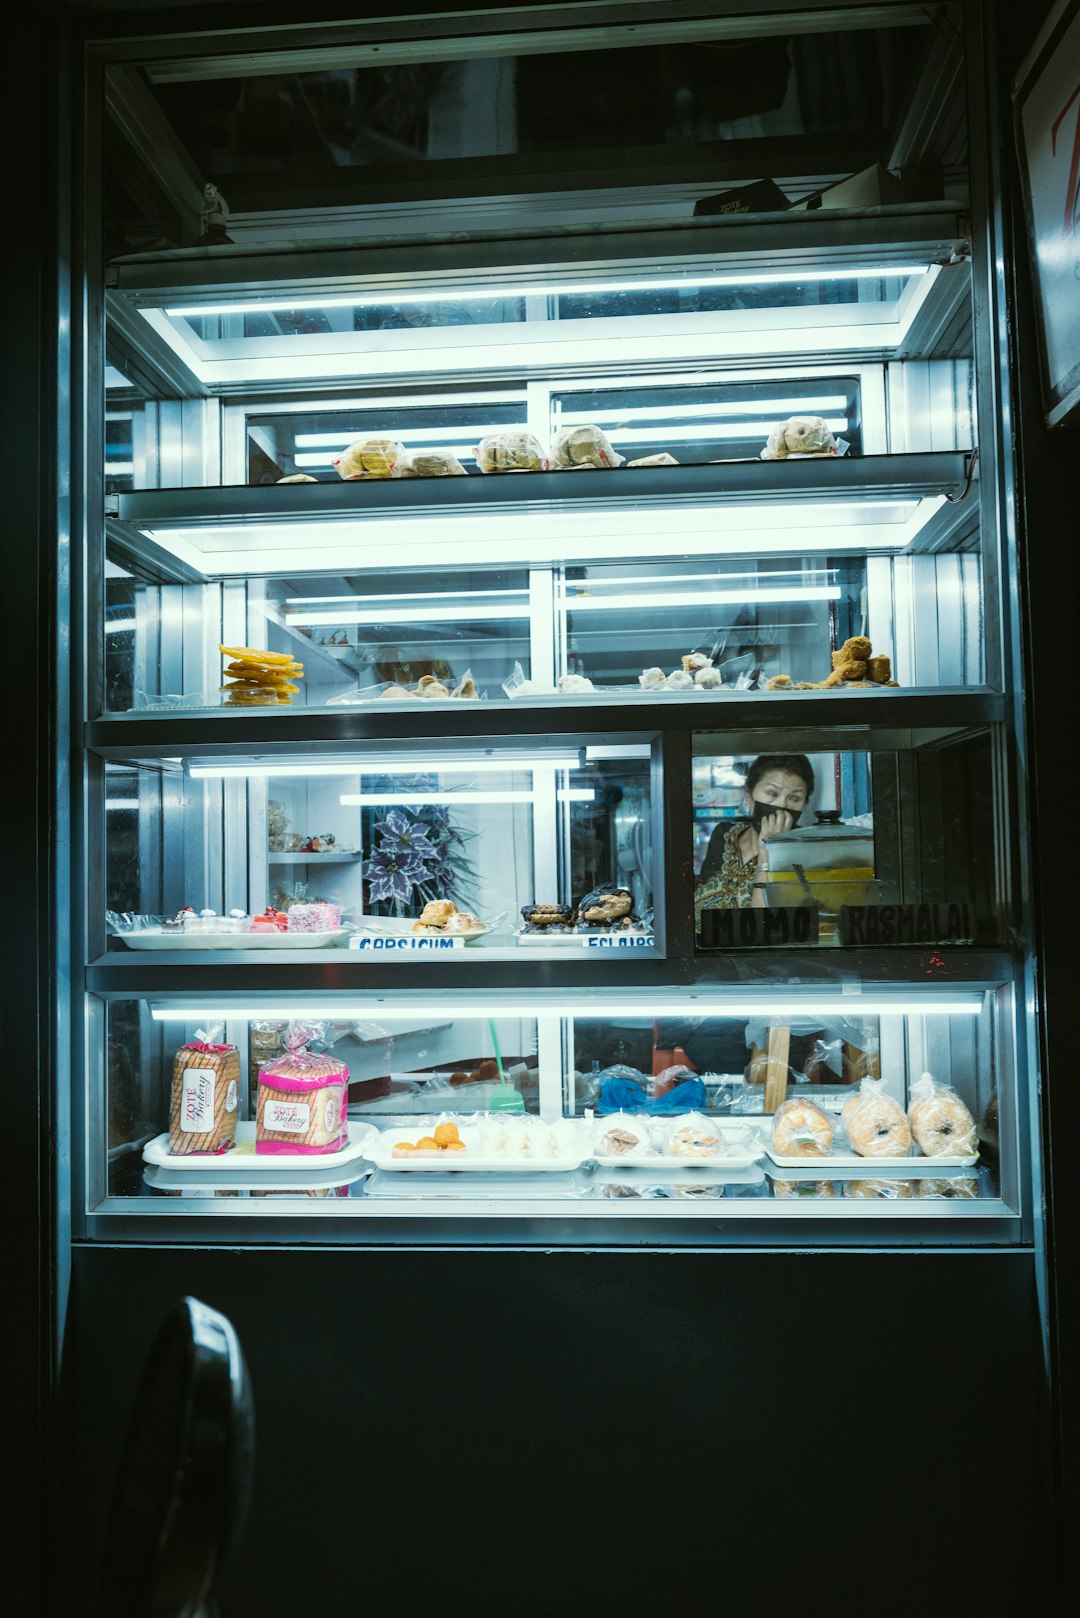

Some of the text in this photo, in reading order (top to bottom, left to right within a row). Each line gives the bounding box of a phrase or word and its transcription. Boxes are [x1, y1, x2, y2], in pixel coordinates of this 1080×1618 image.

[712, 908, 811, 945] MOMO
[847, 904, 970, 944] RASMALAI
[185, 1088, 197, 1120] ZOTÉ
[193, 1075, 210, 1126] Bakery
[273, 1105, 298, 1117] ZOTÉ
[269, 1113, 306, 1129] Bakery
